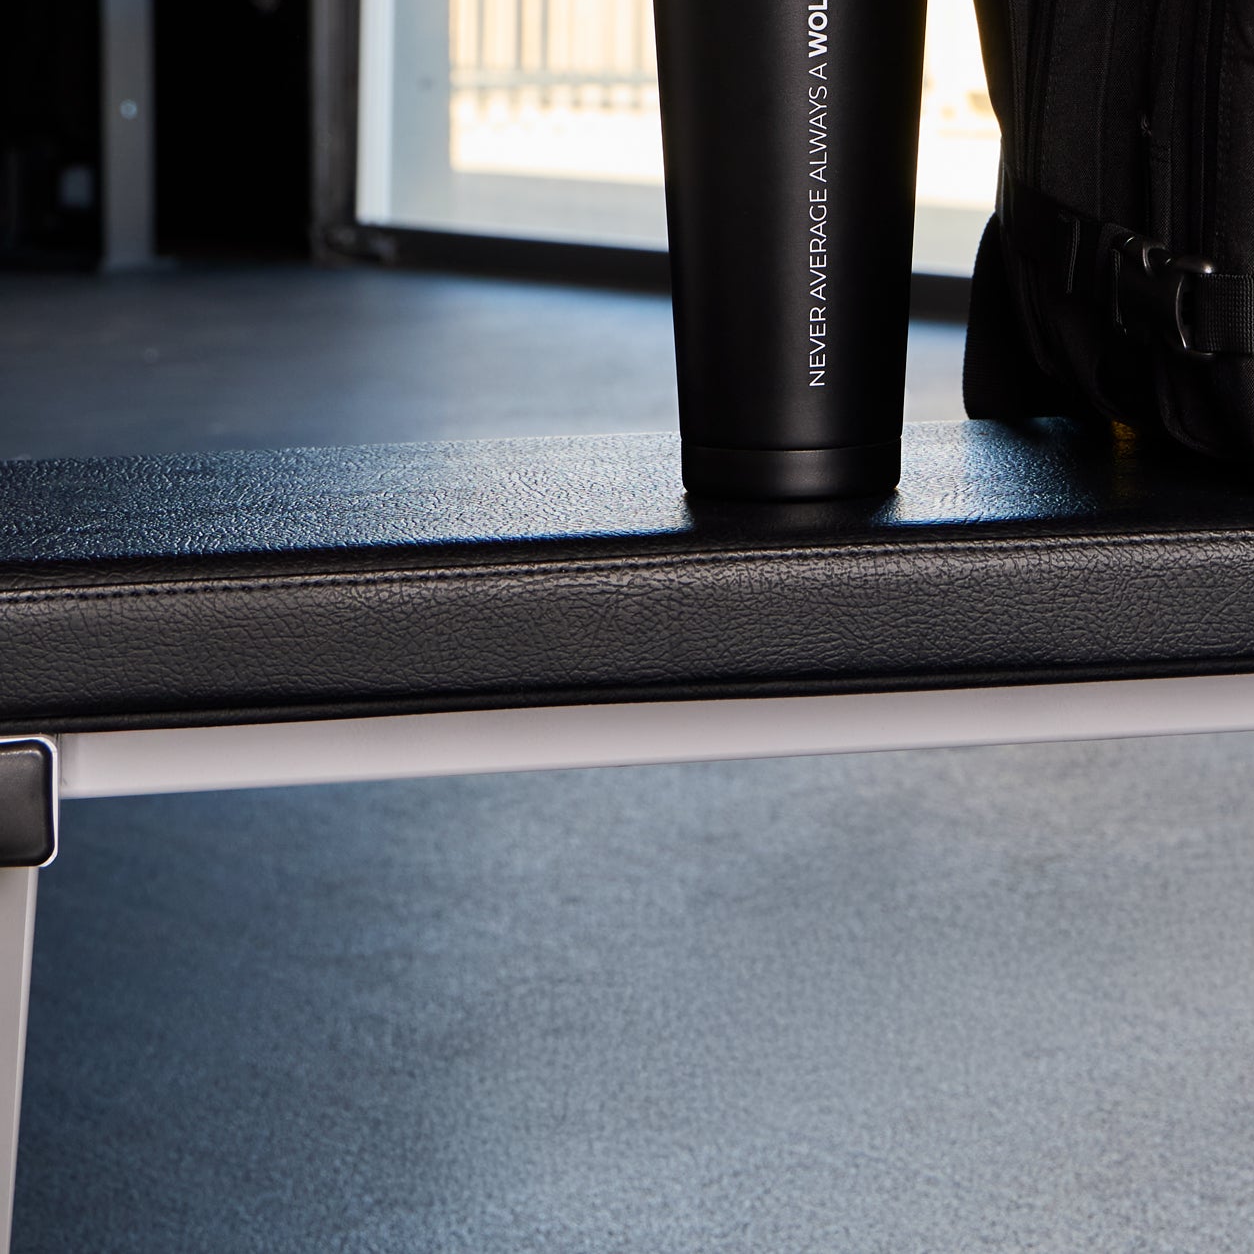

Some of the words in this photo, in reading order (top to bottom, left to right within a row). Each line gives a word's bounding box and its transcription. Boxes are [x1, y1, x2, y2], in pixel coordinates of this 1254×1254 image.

[808, 62, 828, 81] A
[808, 85, 828, 183] ALWAYS
[808, 188, 828, 301] AVERAGE
[808, 306, 827, 387] NEVER
